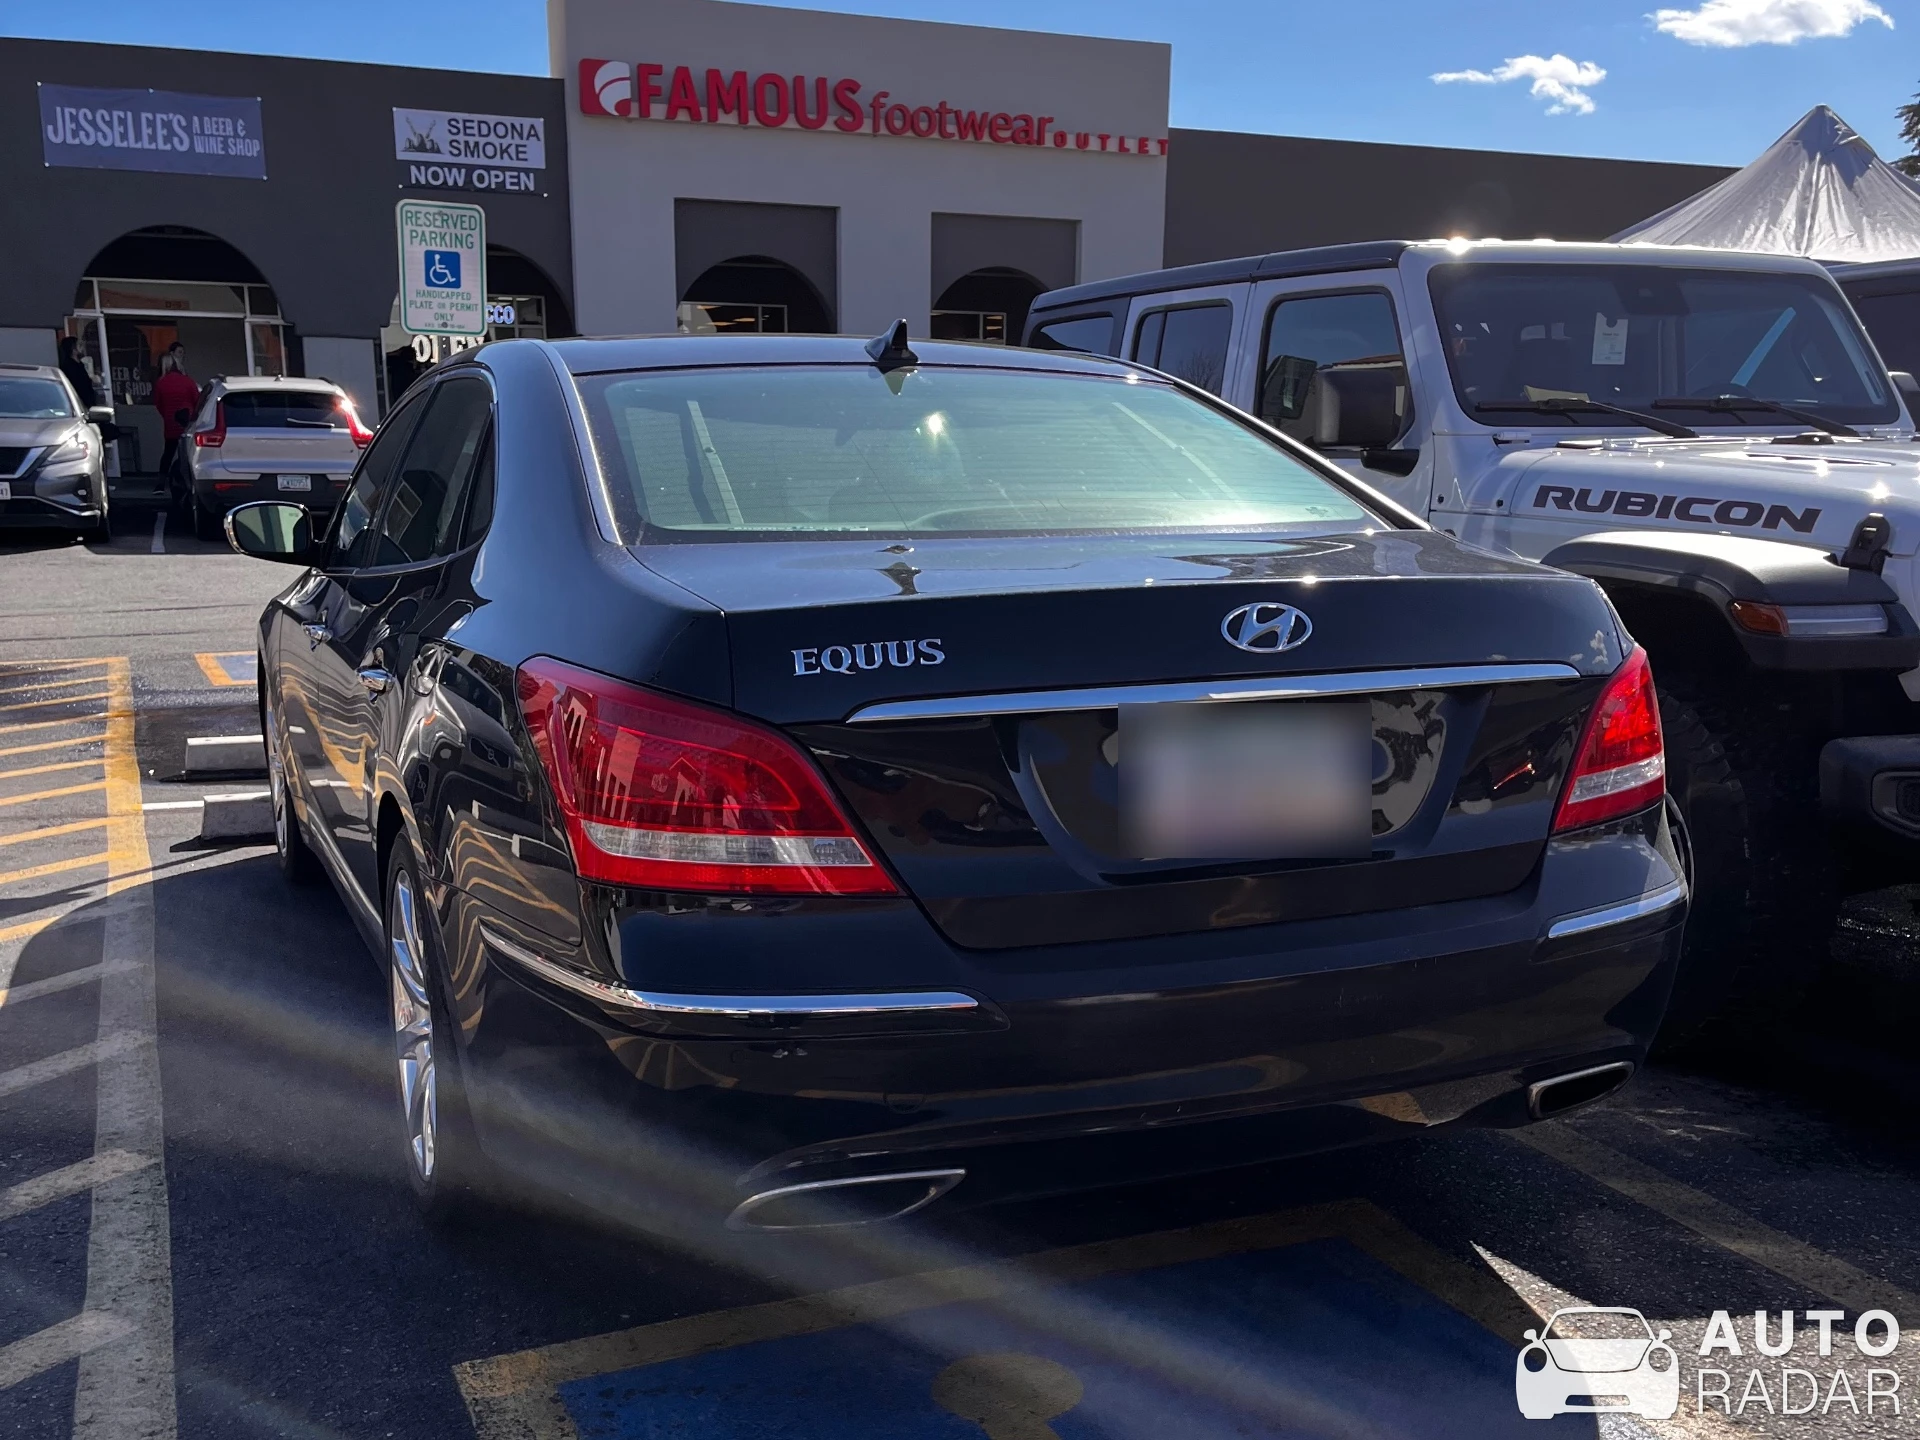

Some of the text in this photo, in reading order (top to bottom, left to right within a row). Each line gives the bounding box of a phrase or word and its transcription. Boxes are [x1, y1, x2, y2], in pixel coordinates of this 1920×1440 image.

[636, 62, 1170, 158] FAMOUS footwear OUTLET
[47, 106, 190, 152] JESSELEE'S
[192, 116, 246, 137] A BEER &
[447, 118, 541, 142] SEDONA
[194, 137, 261, 157] WINE SHOP
[448, 139, 528, 162] SMOKE
[410, 165, 535, 191] NOW OPEN
[405, 210, 478, 231] RESERVED
[409, 229, 475, 250] PARKING
[409, 299, 433, 310] PLATE
[449, 302, 479, 312] PERMIT
[415, 289, 472, 301] HANDICAPPED
[433, 312, 455, 322] ONLY
[112, 366, 130, 381] EER
[125, 381, 153, 396] SHOP
[1533, 484, 1823, 534] RUBICON
[790, 638, 946, 677] EQUUS
